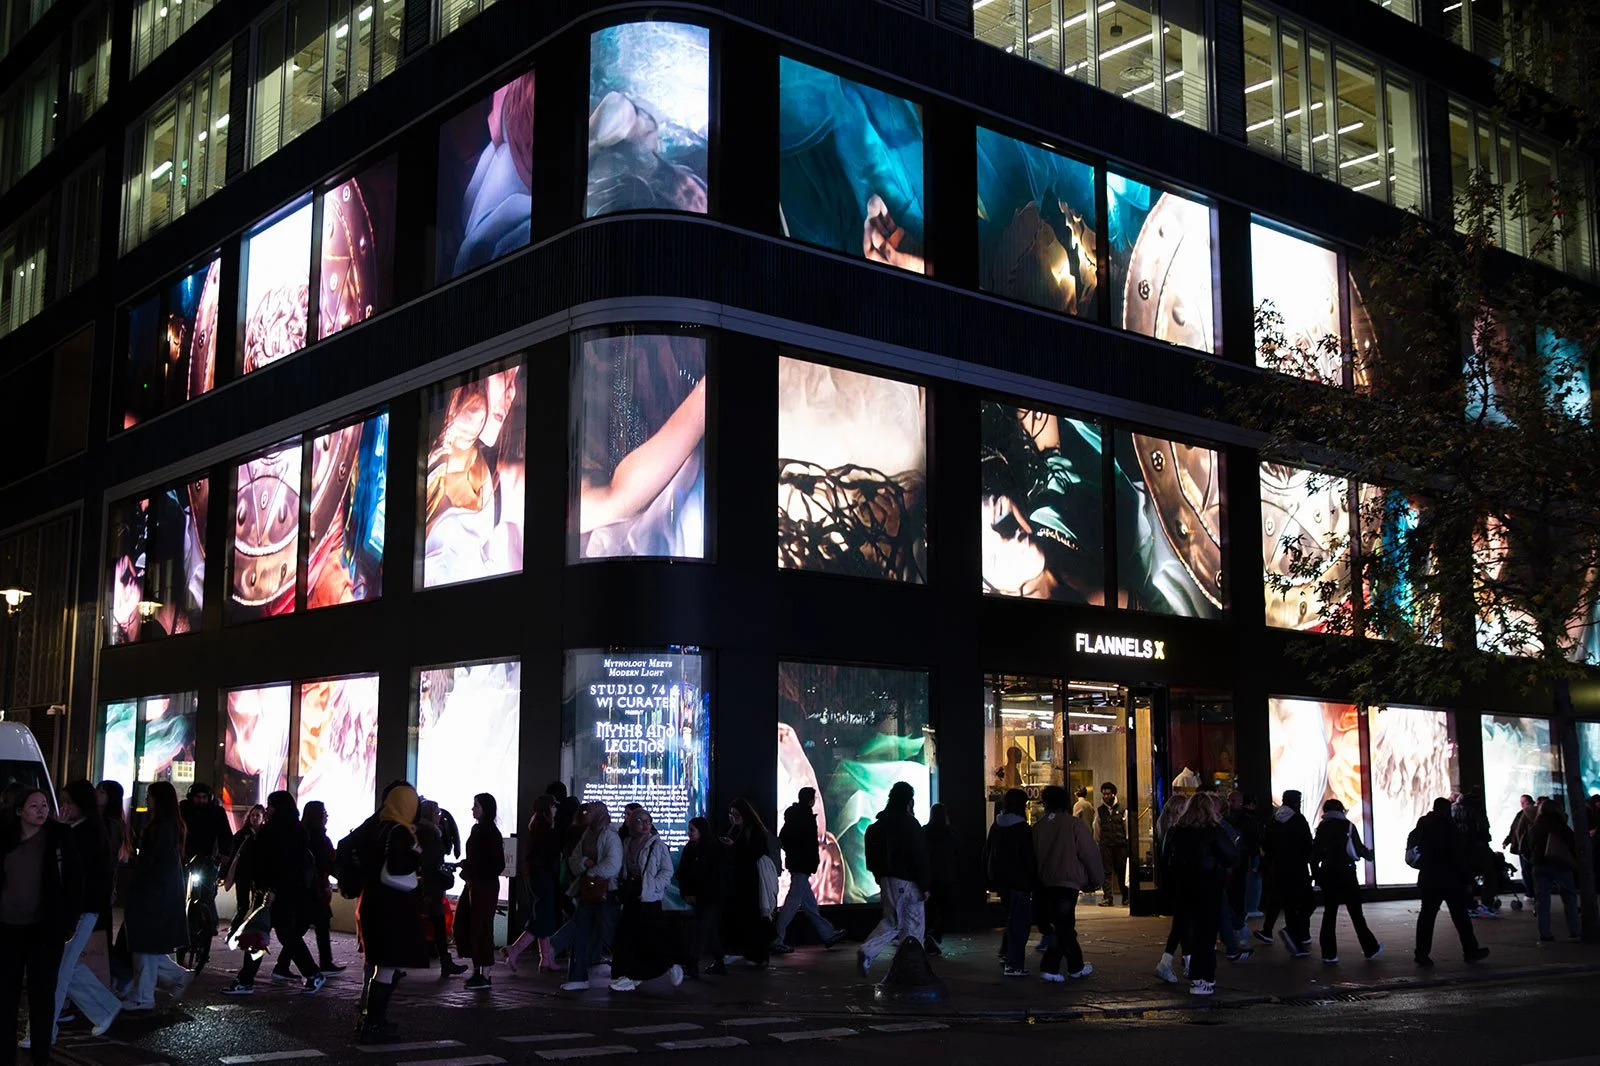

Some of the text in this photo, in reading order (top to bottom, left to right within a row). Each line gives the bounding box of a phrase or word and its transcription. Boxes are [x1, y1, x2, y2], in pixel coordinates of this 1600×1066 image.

[1075, 632, 1154, 659] FLANNELS
[590, 684, 645, 696] STUDIO
[651, 684, 666, 695] 74
[595, 721, 643, 741] MYTHS
[604, 738, 665, 756] LEGENDS
[628, 766, 640, 774] Lee
